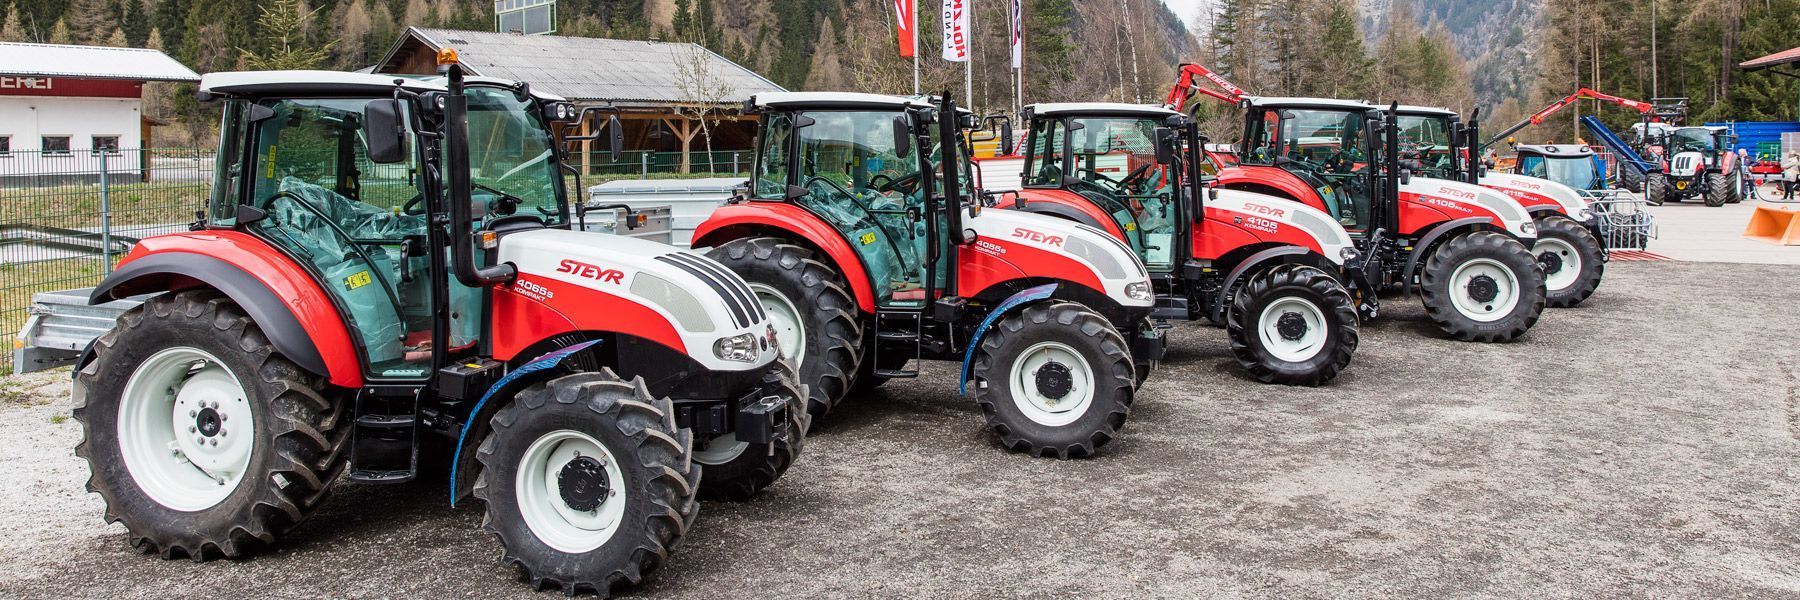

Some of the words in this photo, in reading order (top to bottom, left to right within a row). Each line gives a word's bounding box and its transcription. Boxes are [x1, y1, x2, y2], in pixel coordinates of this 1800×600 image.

[1510, 179, 1541, 190] STEYR
[1438, 186, 1476, 200] STEYR
[1242, 202, 1285, 218] STEYR
[1244, 222, 1278, 234] KOMPAKT
[1247, 217, 1278, 230] 4105
[1011, 227, 1064, 247] STEYR
[974, 245, 1001, 257] KOMPAKT
[556, 258, 625, 285] STEYR
[514, 286, 546, 302] KOMPAKT
